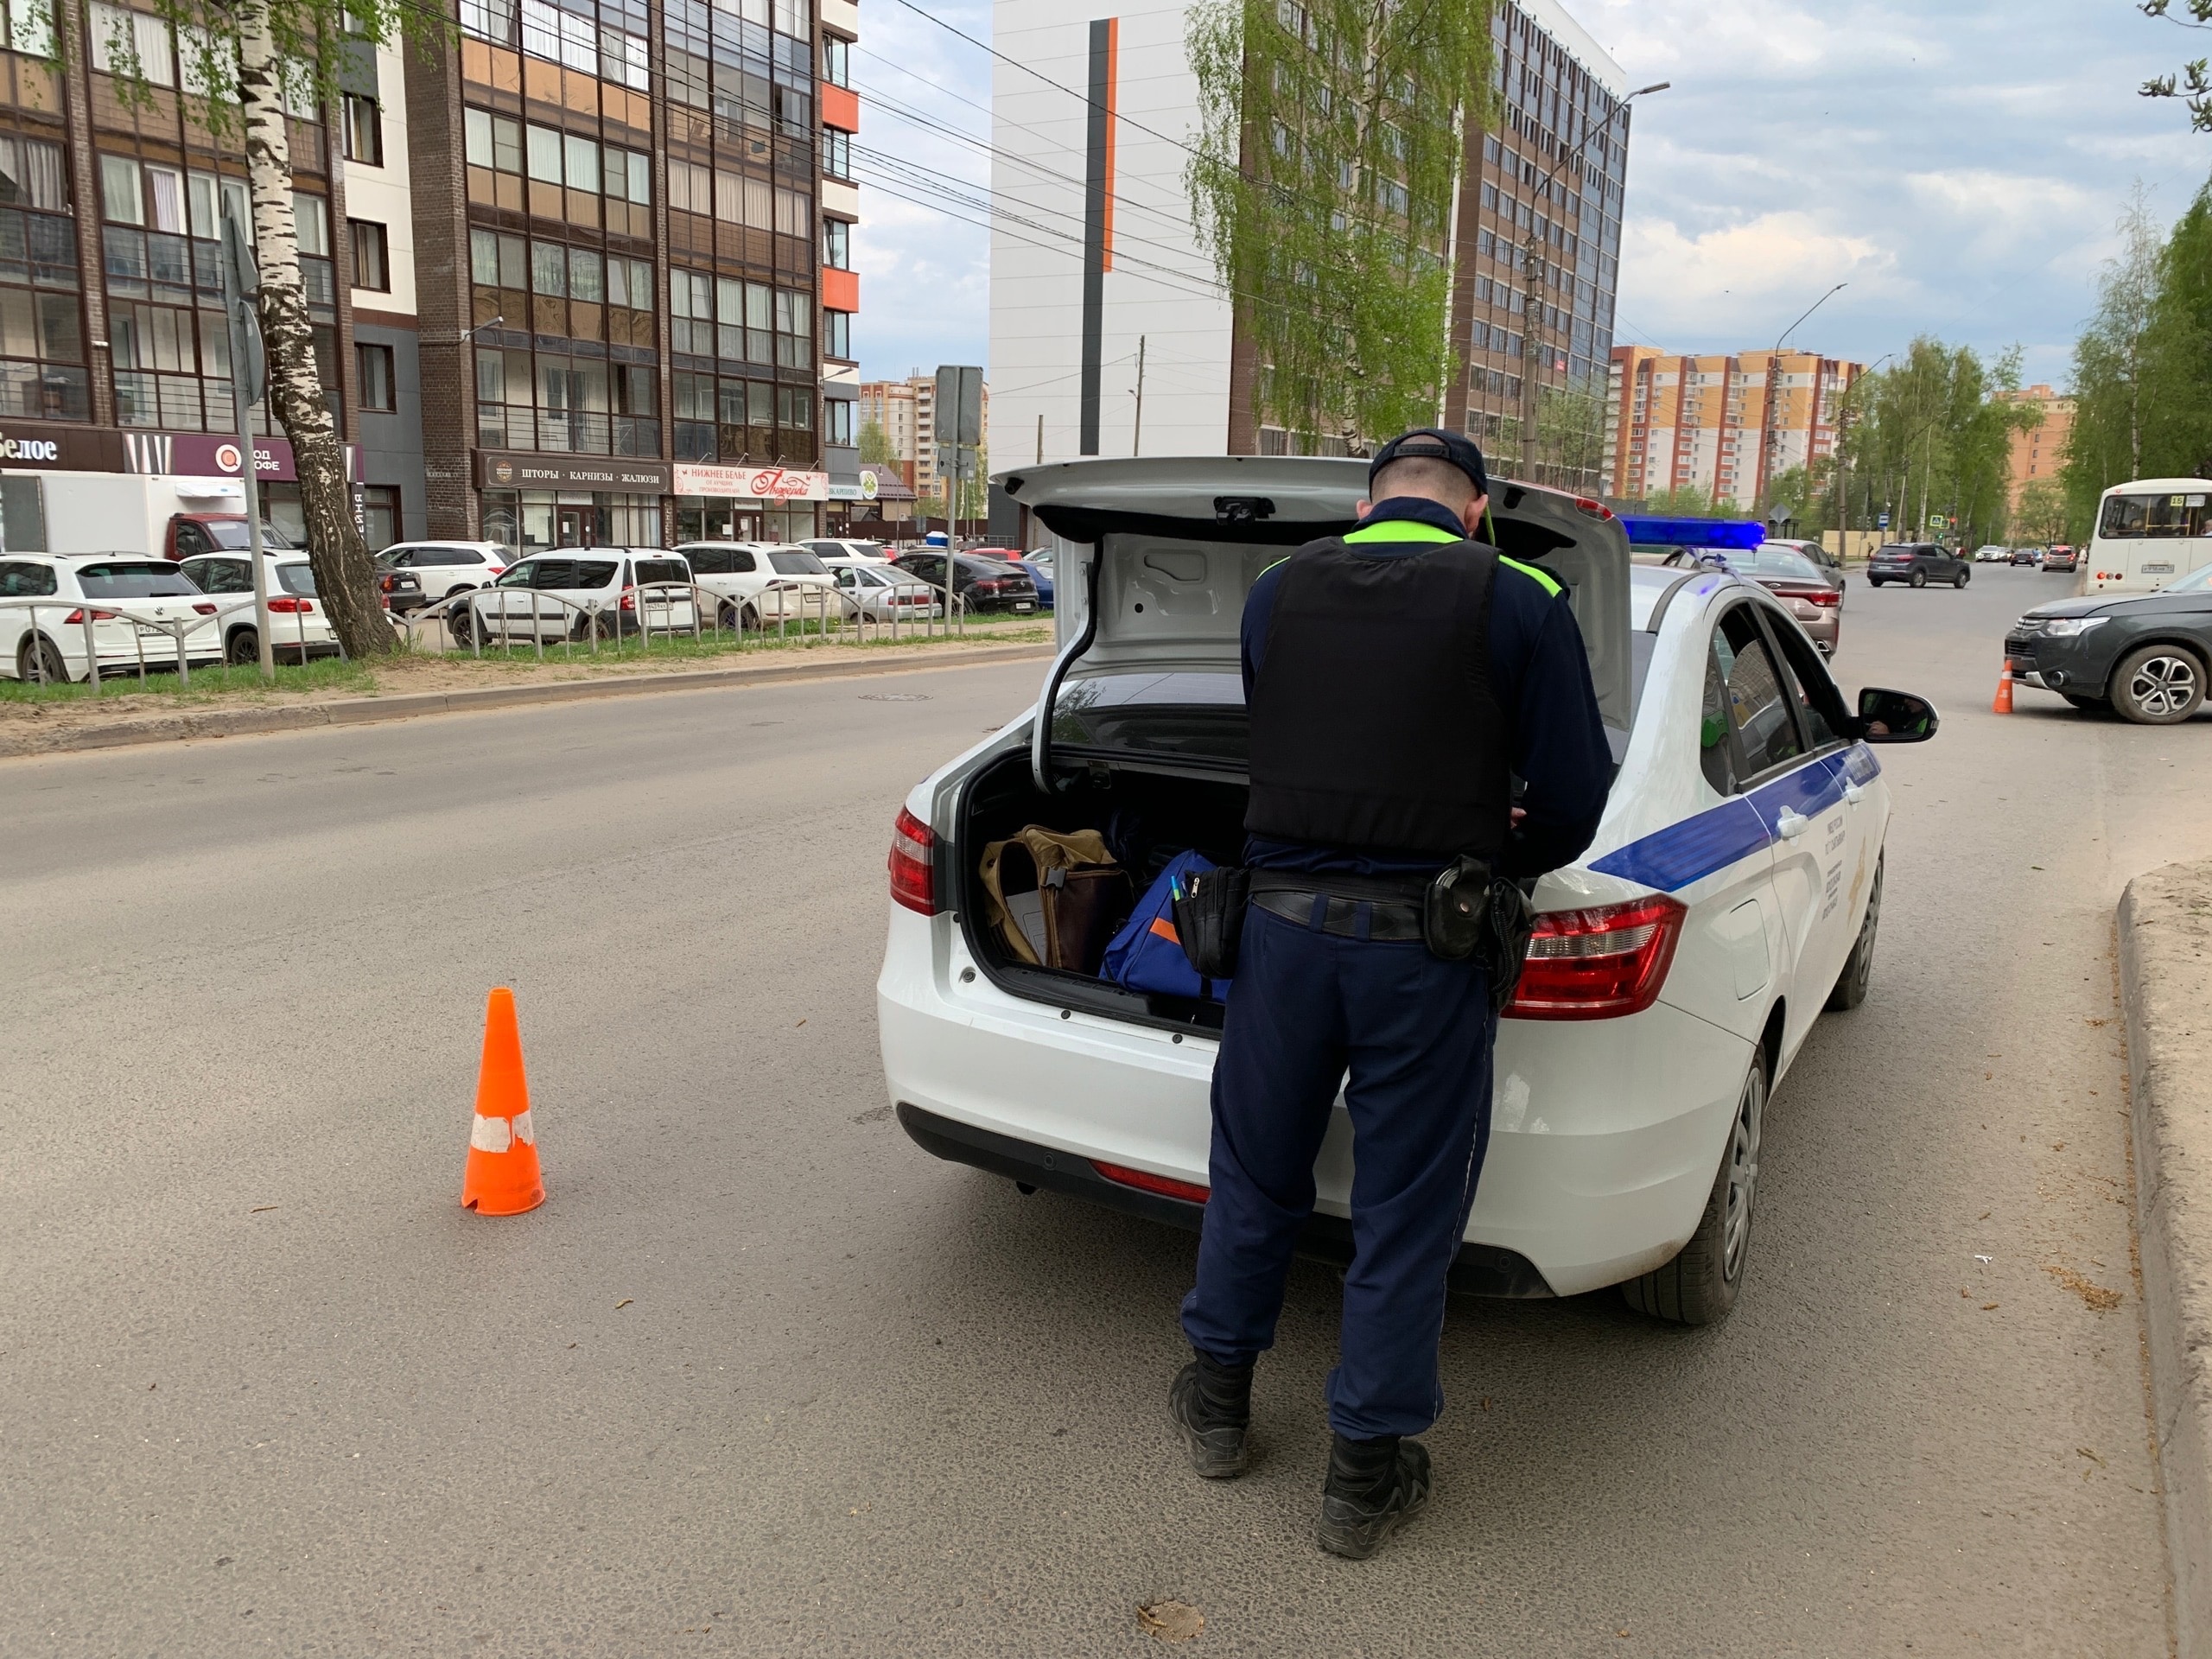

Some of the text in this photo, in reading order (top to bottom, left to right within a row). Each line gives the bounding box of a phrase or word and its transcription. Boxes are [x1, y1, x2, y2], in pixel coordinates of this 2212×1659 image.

[253, 449, 271, 460] ОД
[253, 461, 280, 471] ОФЕ
[521, 468, 559, 480] ШТОРЫ
[569, 471, 613, 481] КАРНИЗЫ
[621, 474, 660, 484] ЖАЛЮЗИ
[691, 468, 747, 480] НИЖНЕЕ БЕЛЬЕ
